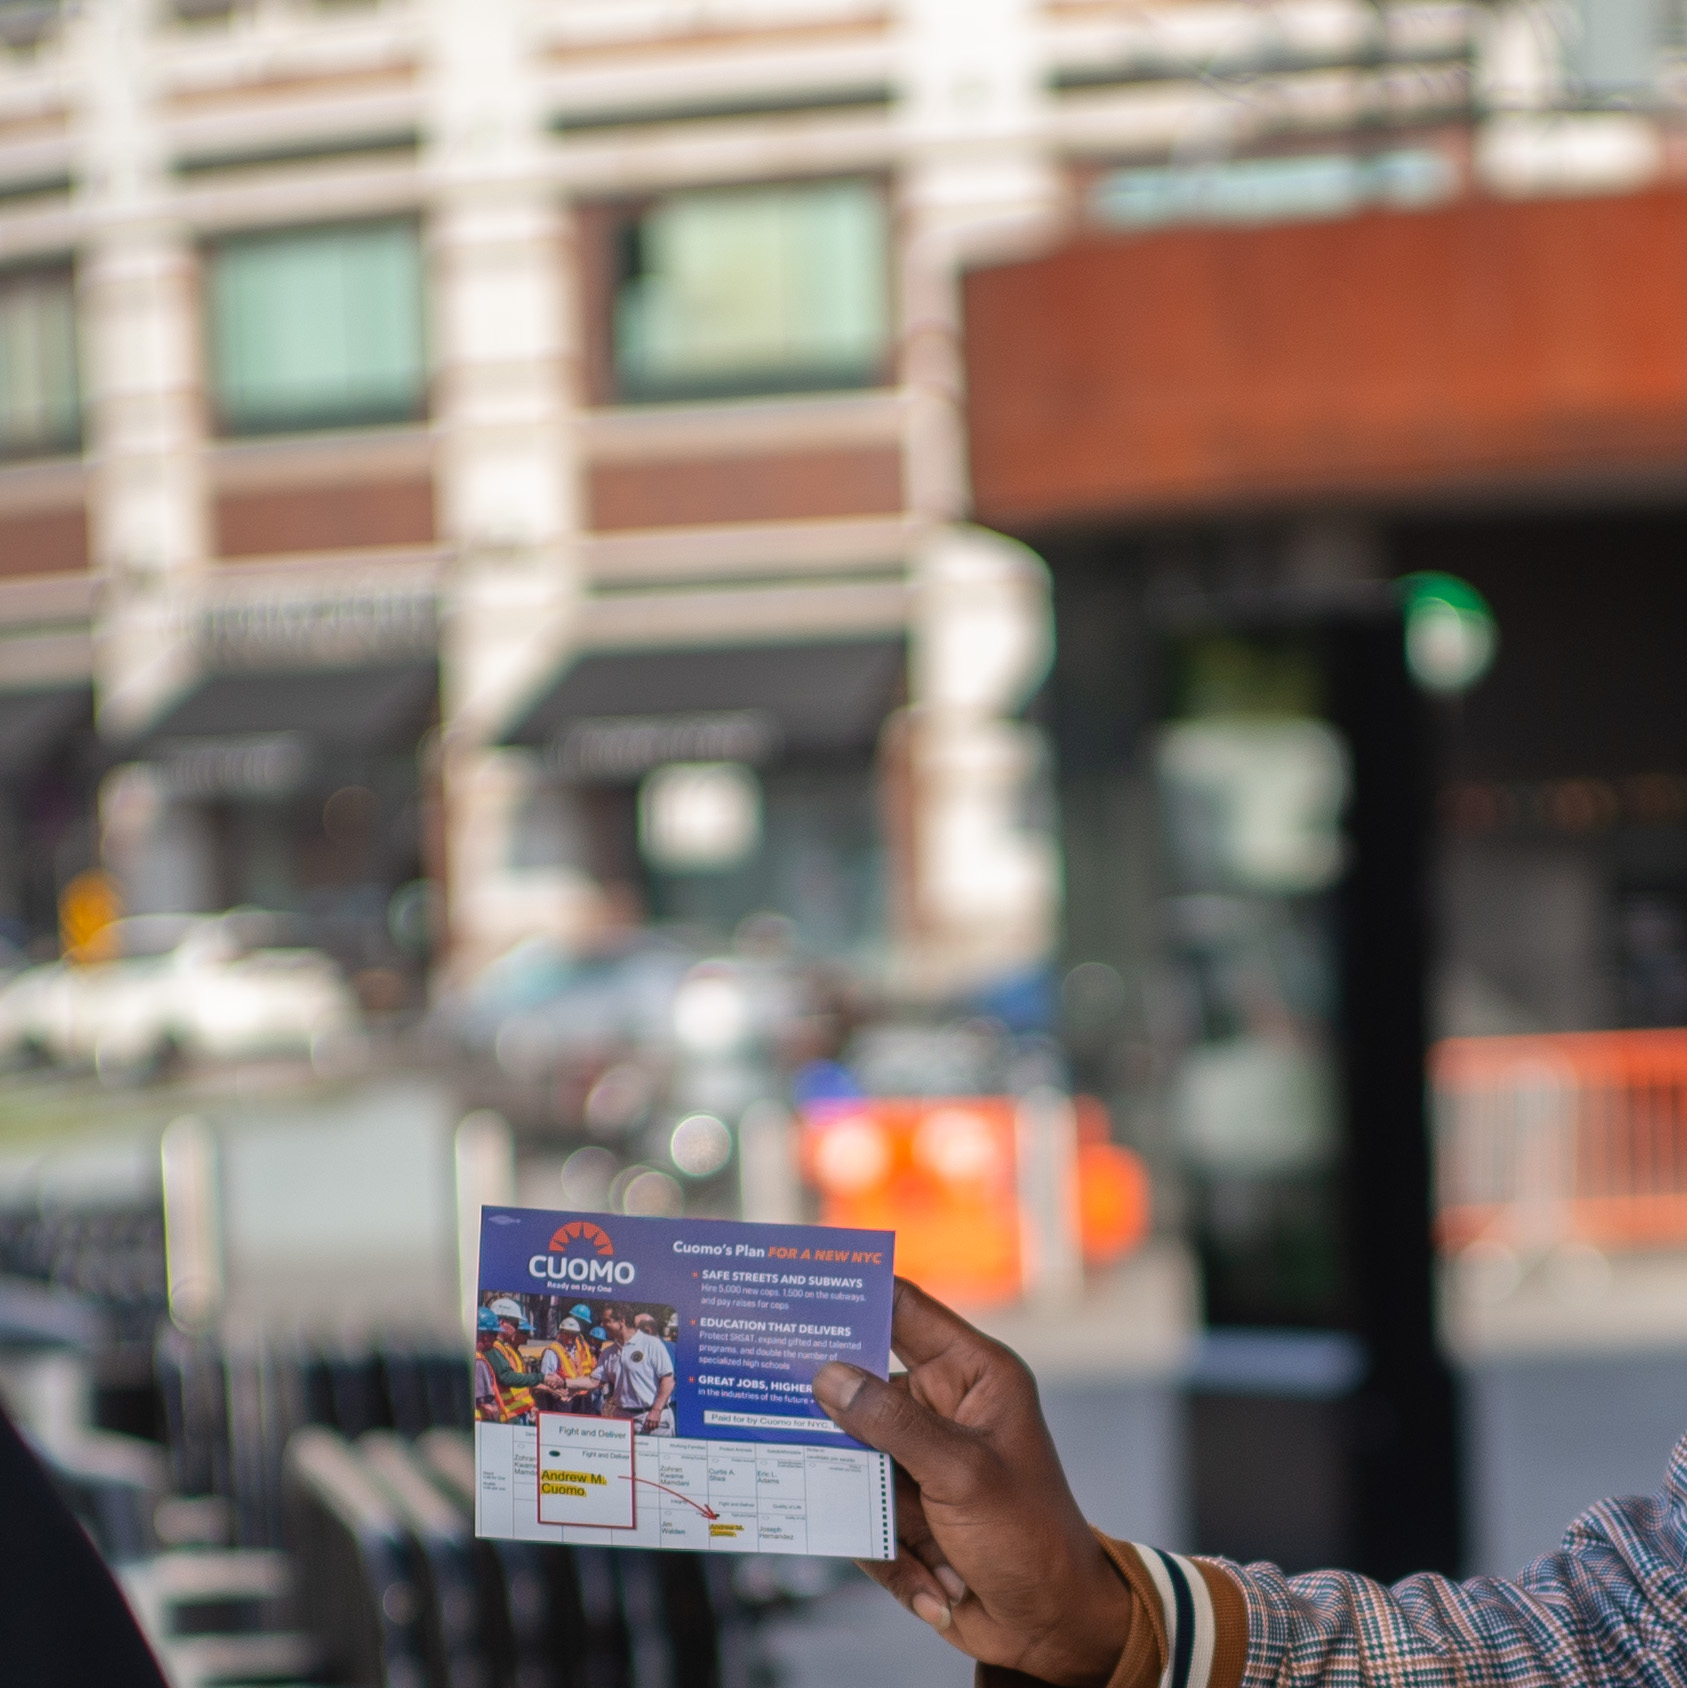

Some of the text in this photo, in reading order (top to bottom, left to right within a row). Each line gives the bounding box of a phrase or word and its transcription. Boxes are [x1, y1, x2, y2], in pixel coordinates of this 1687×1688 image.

[672, 1240, 881, 1265] Cuomo's Plan FOR A NEW NYC
[528, 1254, 635, 1284] CUOMO
[702, 1269, 862, 1288] SAFE STREETS AND SUBWAYS
[547, 1280, 568, 1291] Ready
[582, 1283, 595, 1292] Day
[597, 1284, 612, 1293] One
[701, 1283, 716, 1293] Hire
[816, 1290, 828, 1299] the
[701, 1296, 788, 1310] and pay raises for cops
[700, 1318, 851, 1336] EDUCATION THAT DELIVERS
[699, 1331, 728, 1340] Protect
[758, 1336, 786, 1346] expand
[788, 1337, 809, 1347] gifted
[811, 1339, 827, 1347] and
[828, 1340, 861, 1350] talented
[740, 1346, 754, 1354] and
[756, 1347, 781, 1356] double
[783, 1349, 796, 1357] the
[797, 1350, 827, 1360] number
[829, 1352, 837, 1360] of
[699, 1356, 790, 1369] specialized high schools
[698, 1375, 812, 1393] GREAT JOBS, HIGHER
[706, 1388, 720, 1396] the
[721, 1390, 758, 1400] industries
[784, 1395, 807, 1403] future
[711, 1413, 731, 1421] Paid
[733, 1415, 744, 1423] for
[746, 1416, 757, 1425] by
[759, 1417, 791, 1426] Cuomo
[794, 1419, 805, 1427] for
[808, 1420, 829, 1429] NYC,
[558, 1426, 625, 1439] Fight and Deliver
[582, 1450, 596, 1458] Fight
[541, 1470, 587, 1482] Andrew
[541, 1483, 584, 1495] Cuomo
